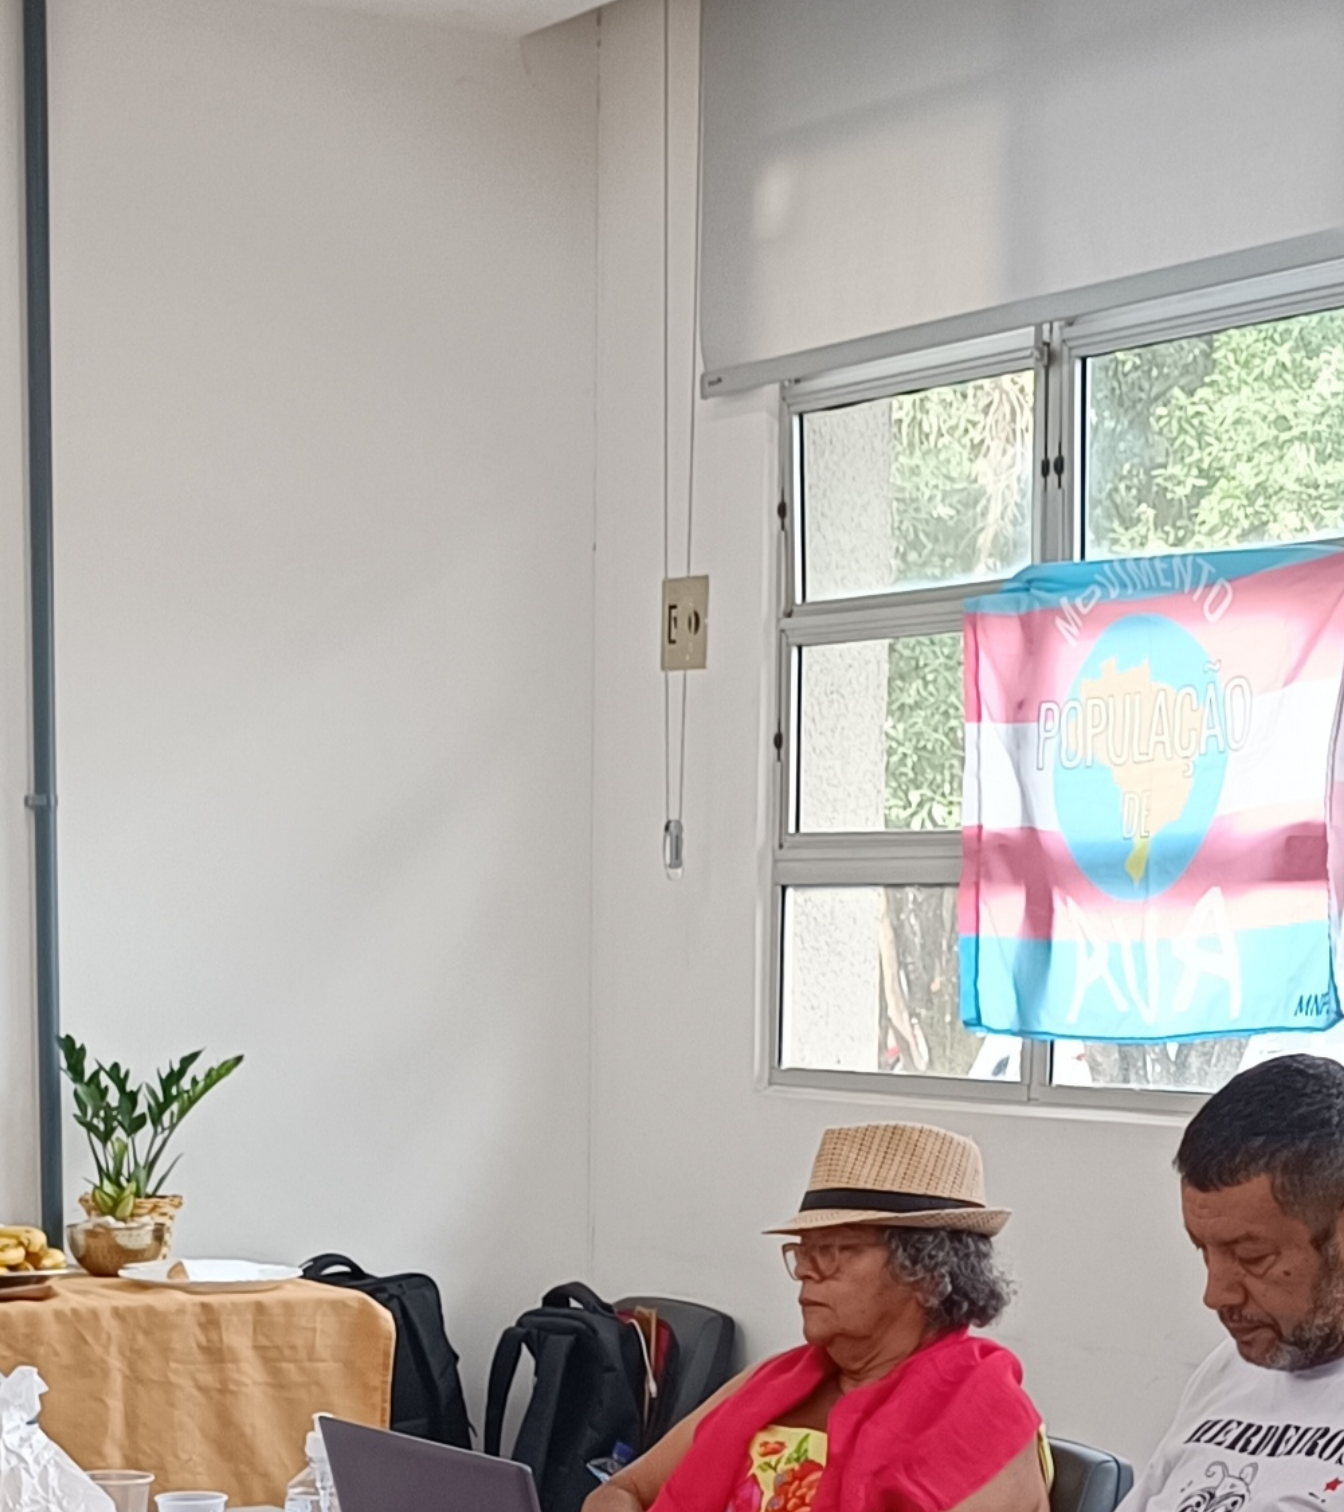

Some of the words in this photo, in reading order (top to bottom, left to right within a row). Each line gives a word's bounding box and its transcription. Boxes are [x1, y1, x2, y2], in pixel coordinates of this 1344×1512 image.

[1055, 553, 1233, 648] MOVIMENTO
[1037, 660, 1253, 777] POPULAÇÃO
[1122, 790, 1150, 840] DE
[1065, 886, 1242, 1024] RUA
